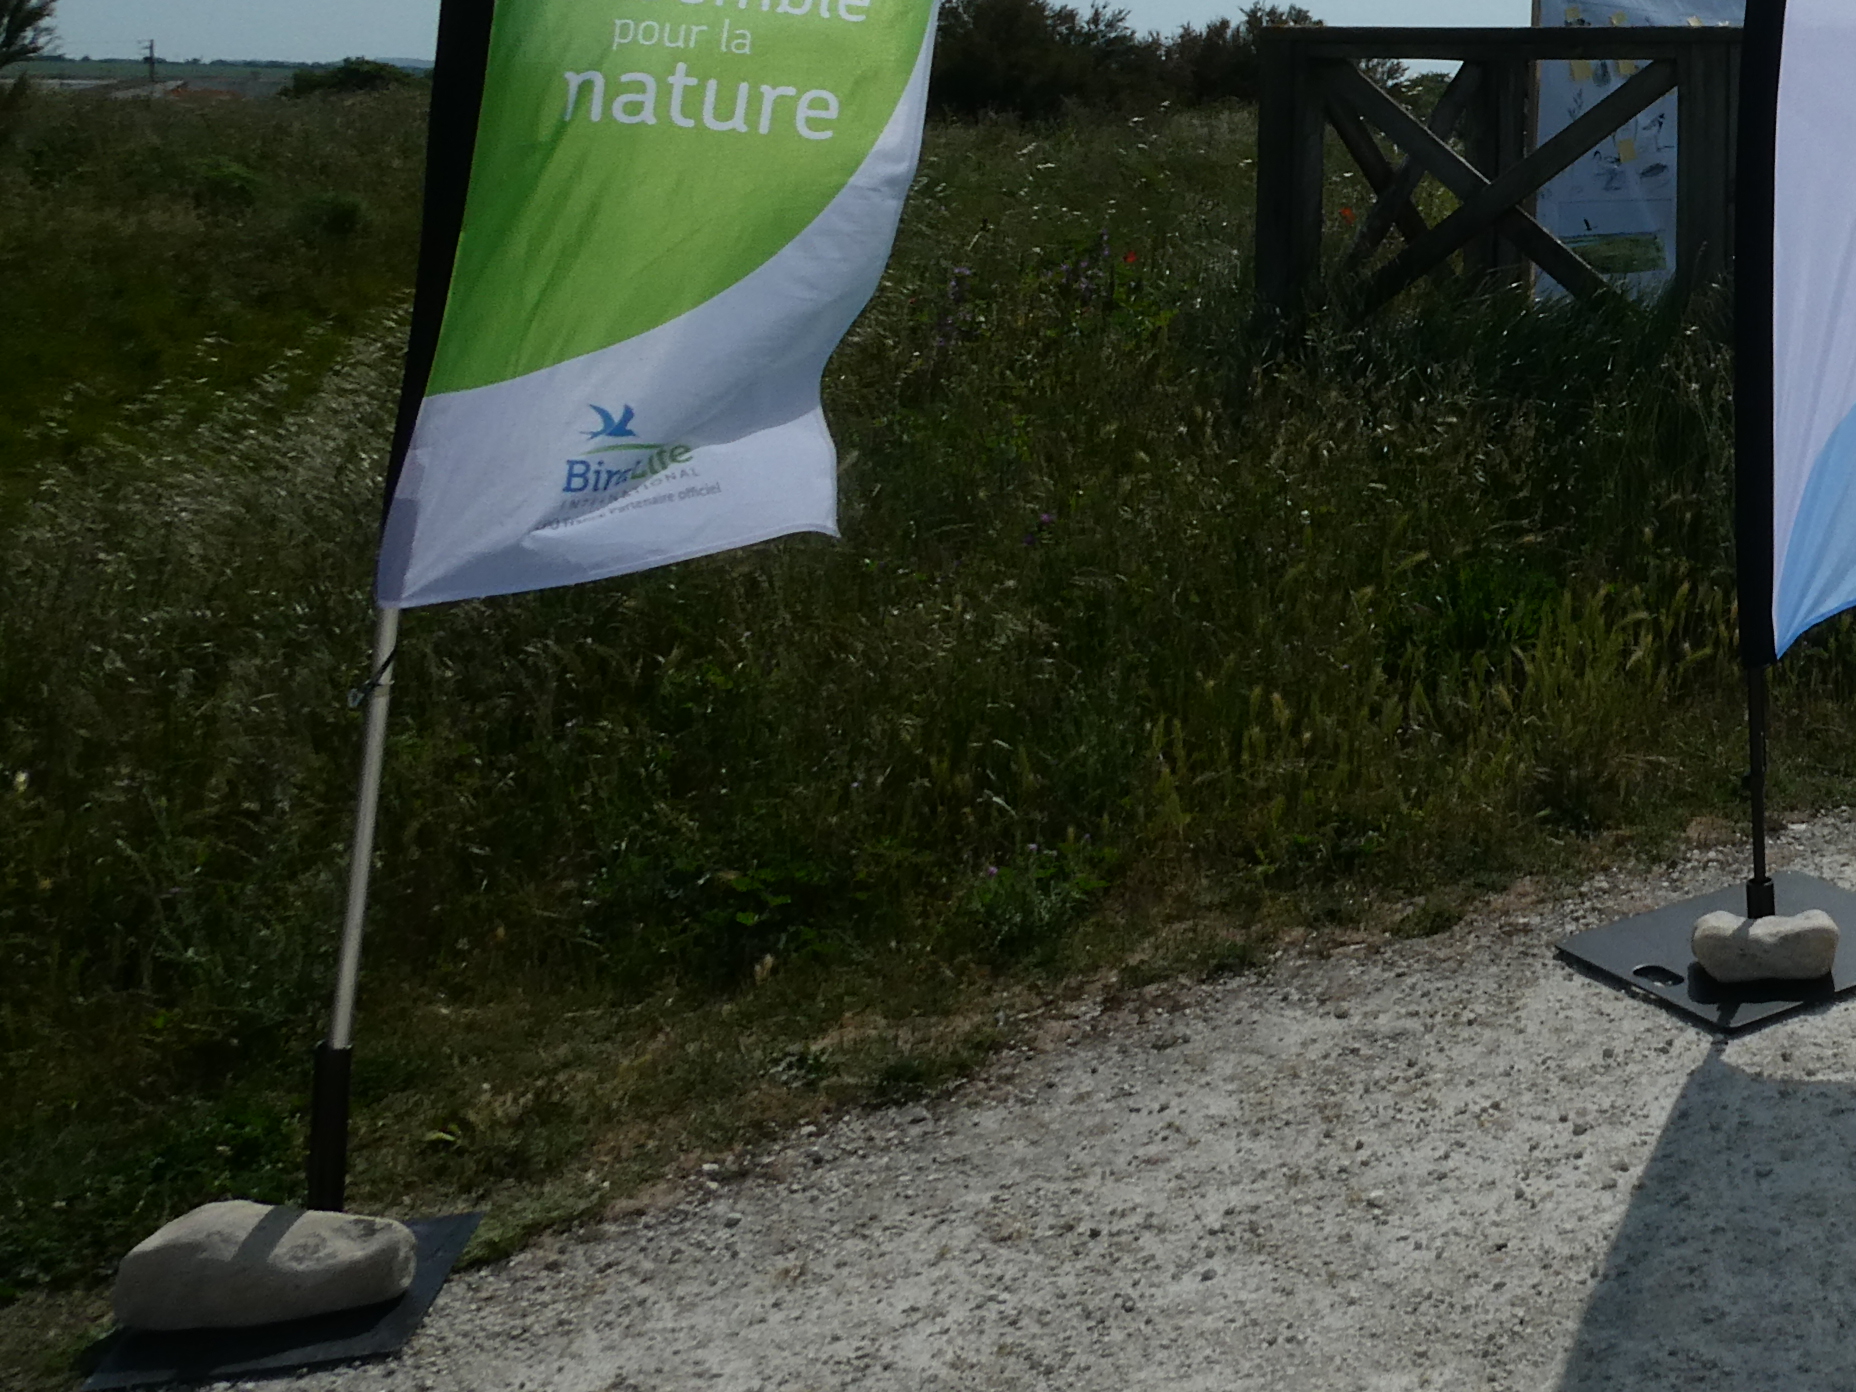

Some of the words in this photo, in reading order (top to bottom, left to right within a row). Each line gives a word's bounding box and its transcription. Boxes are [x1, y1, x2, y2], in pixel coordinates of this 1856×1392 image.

[611, 18, 708, 51] pour
[721, 18, 752, 55] la
[563, 61, 840, 141] nature
